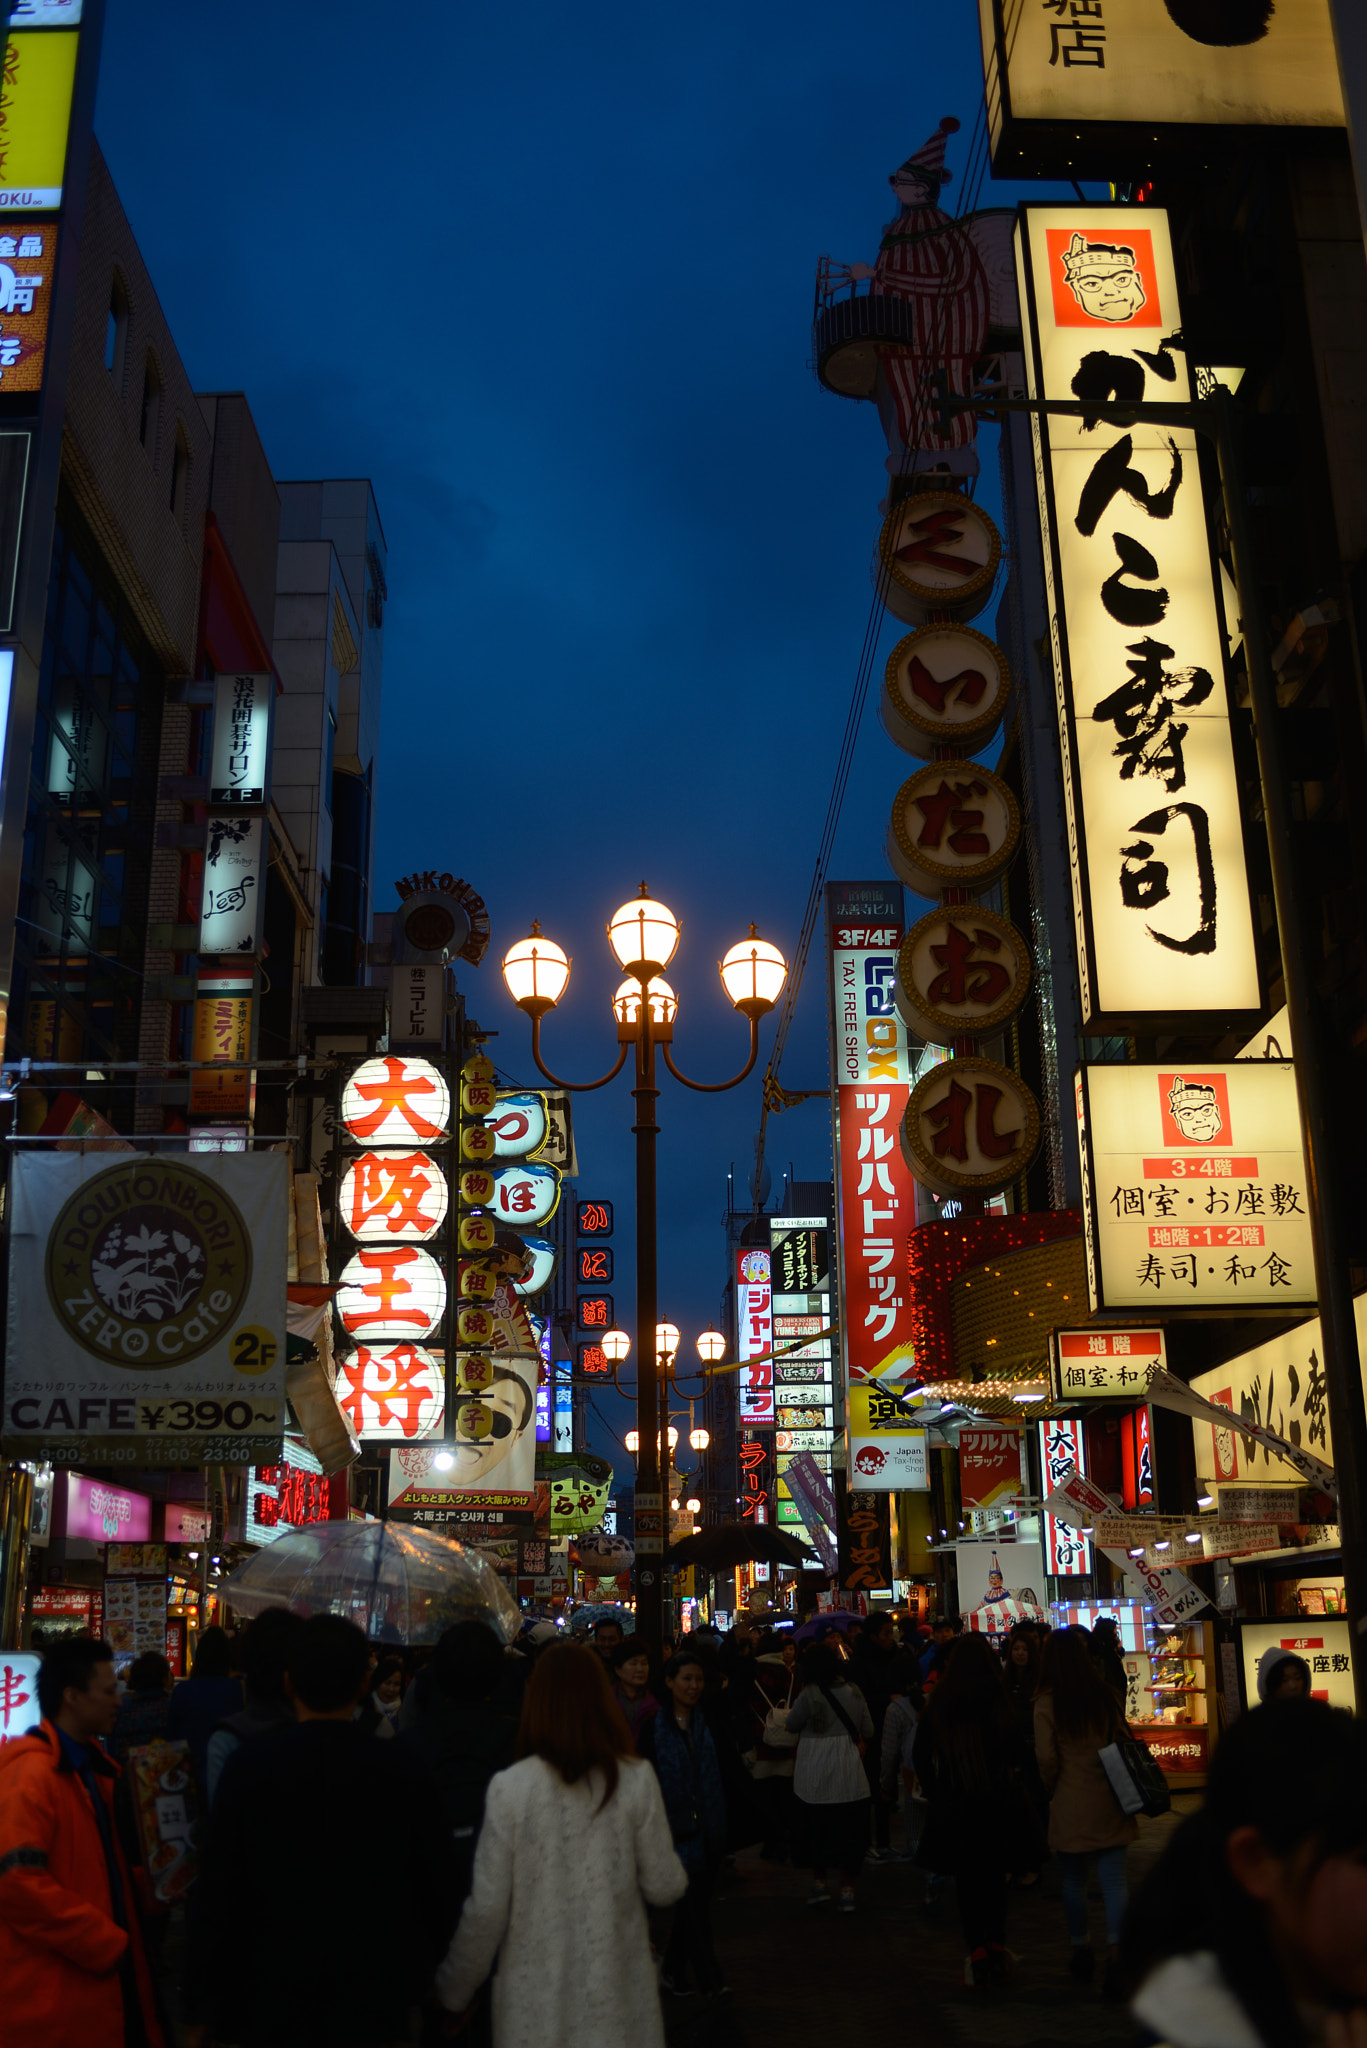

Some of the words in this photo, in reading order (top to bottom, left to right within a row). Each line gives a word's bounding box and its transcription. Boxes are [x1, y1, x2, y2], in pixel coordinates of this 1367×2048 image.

[227, 676, 255, 787] 浪花囲碁サロン
[837, 928, 898, 947] 3F/4F
[842, 958, 856, 988] TAX
[843, 992, 858, 1032] FREE
[845, 1036, 860, 1080] SHOP
[63, 1174, 236, 1251] DOUTONBORI
[1109, 1183, 1306, 1218] 個室・お座敷
[854, 1092, 904, 1343] ツルハドラッグ
[339, 1056, 449, 1438] 大阪王将
[63, 1288, 151, 1358] ZERO
[233, 1332, 277, 1366] 2F
[1088, 1335, 1132, 1355] 地階
[10, 1398, 137, 1430] CAFE
[896, 1447, 925, 1457] Japan.
[962, 1433, 1019, 1452] ツルハ
[893, 1456, 925, 1466] Tax-free
[904, 1464, 925, 1474] Shop
[962, 1454, 1009, 1469] ドラッグ
